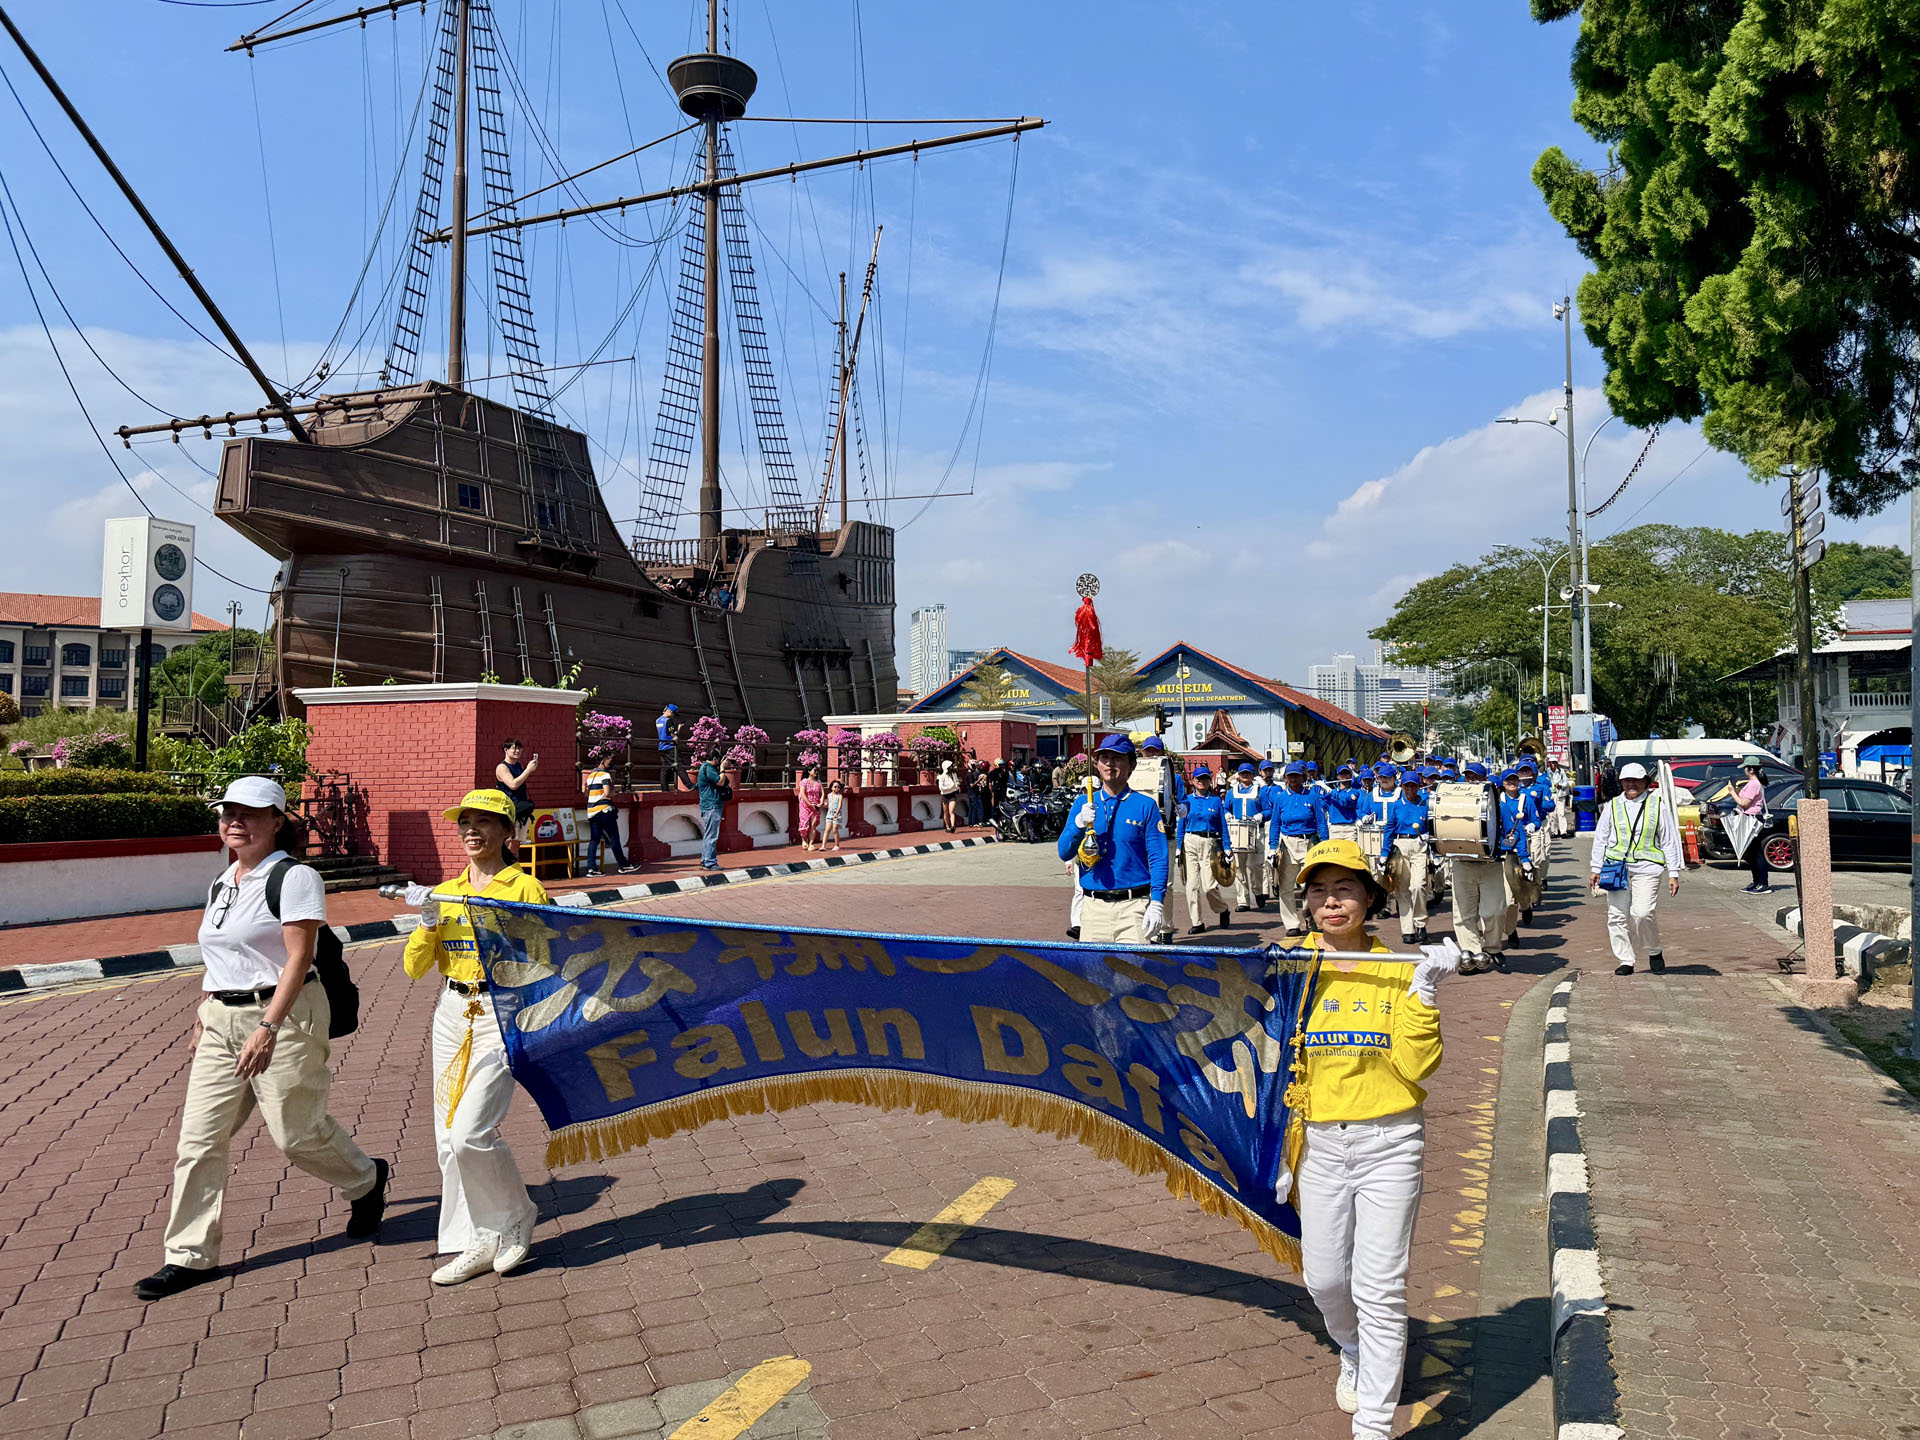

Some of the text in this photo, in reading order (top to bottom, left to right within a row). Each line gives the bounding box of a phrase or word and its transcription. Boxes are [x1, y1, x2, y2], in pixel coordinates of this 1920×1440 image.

[1155, 683, 1213, 694] MUSEUM
[1354, 1034, 1388, 1047] DAFA
[586, 1000, 1240, 1193] Falun Dafa
